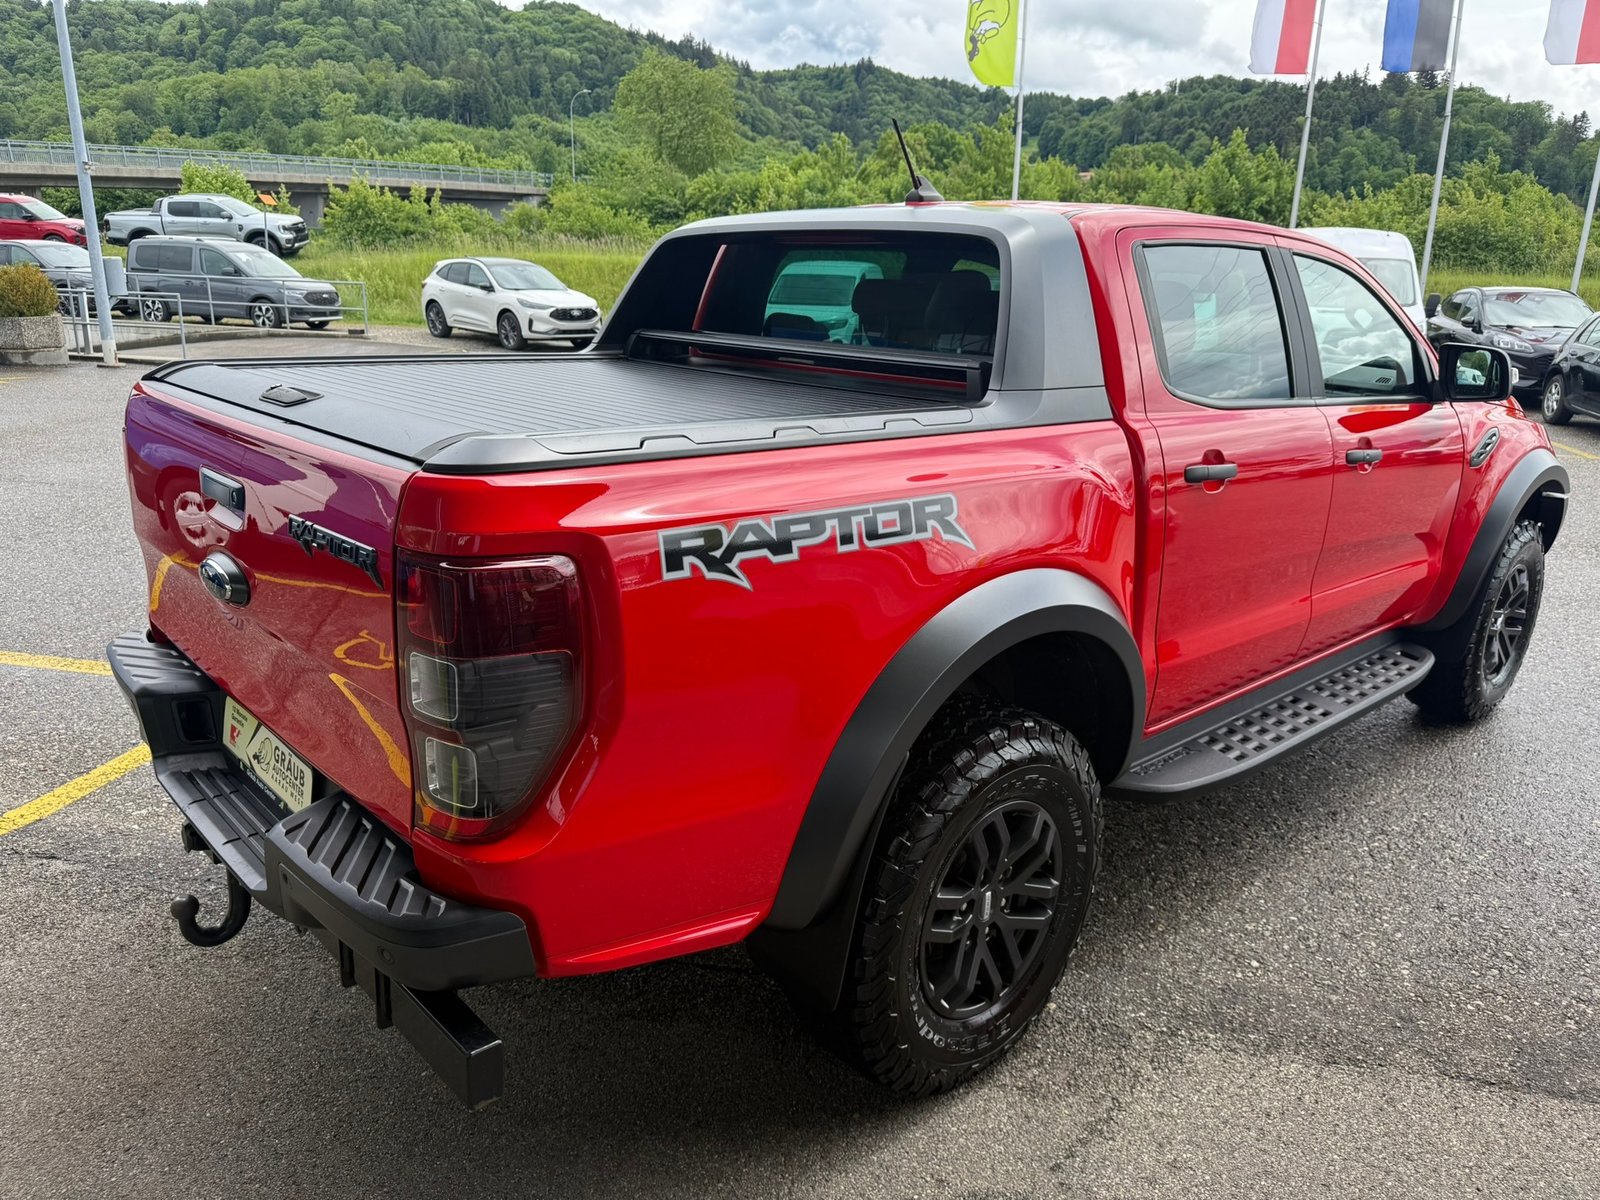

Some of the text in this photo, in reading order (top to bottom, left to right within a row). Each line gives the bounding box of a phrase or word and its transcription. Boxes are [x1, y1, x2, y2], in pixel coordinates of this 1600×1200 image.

[288, 513, 385, 592] RAPTOR
[657, 492, 977, 592] RAPTOR
[272, 763, 304, 799] AUTOCENTER
[273, 745, 305, 787] GRÄUB
